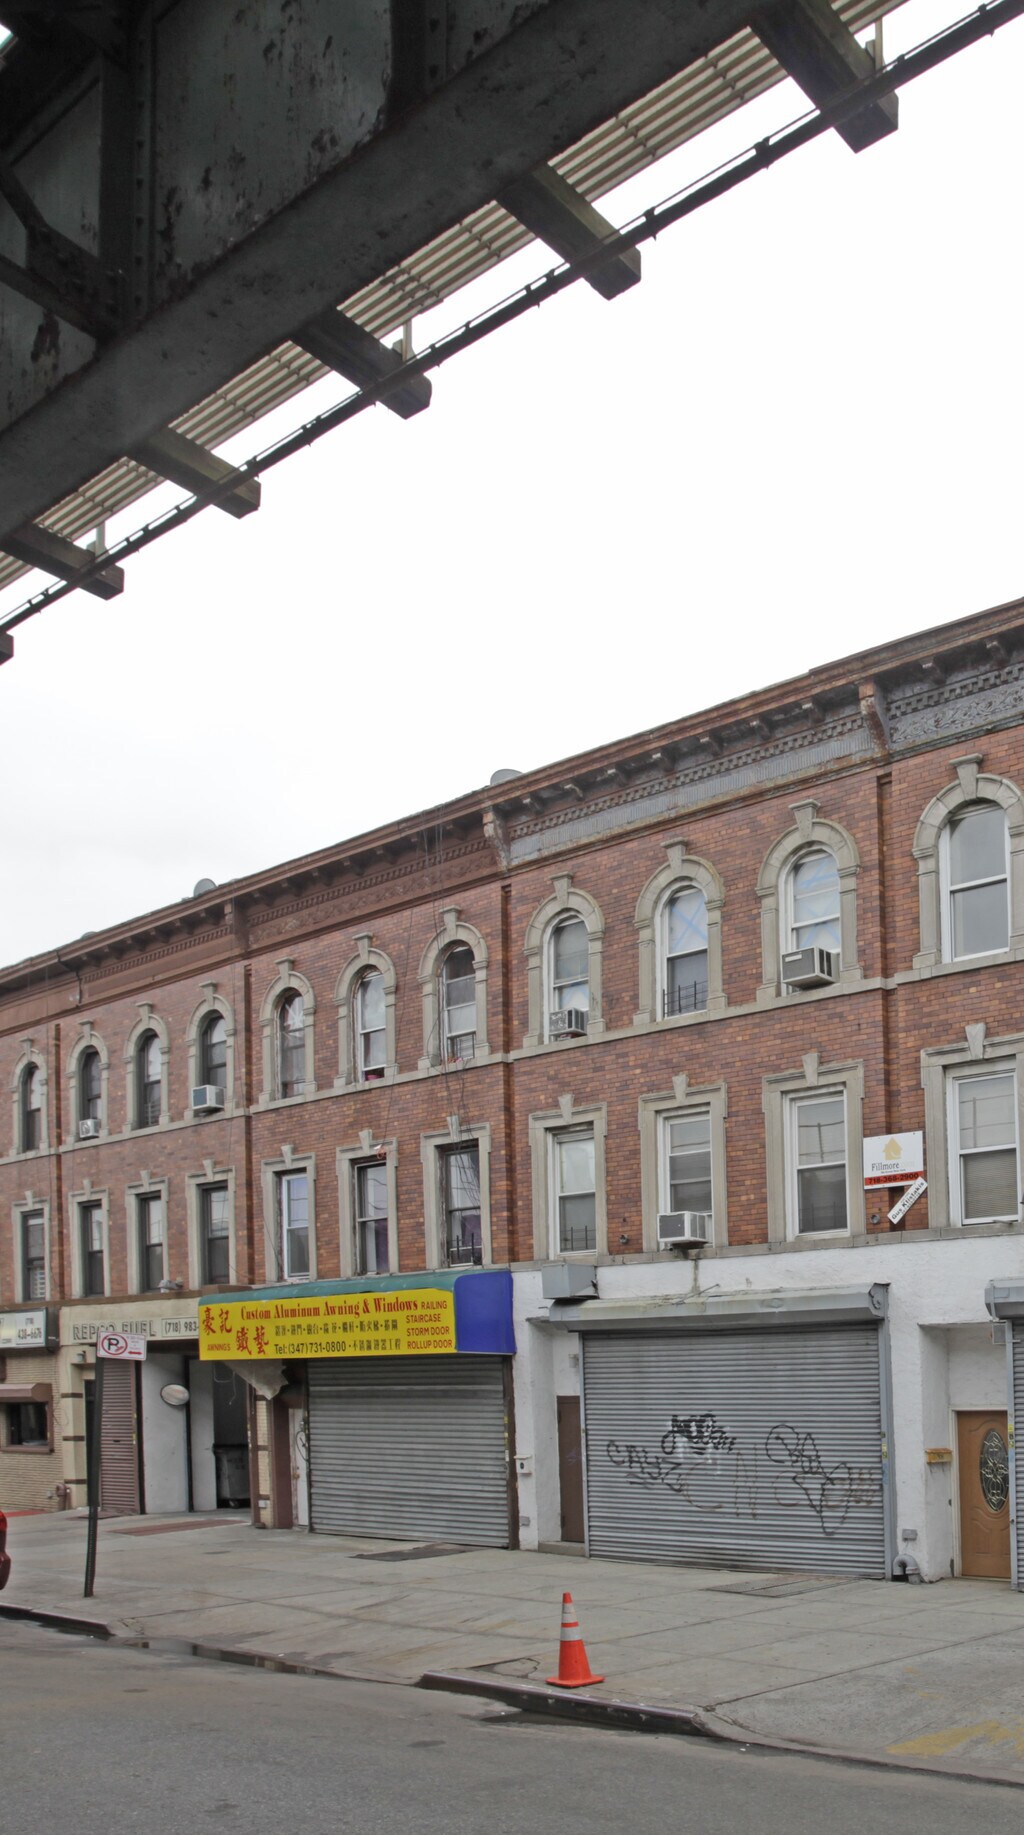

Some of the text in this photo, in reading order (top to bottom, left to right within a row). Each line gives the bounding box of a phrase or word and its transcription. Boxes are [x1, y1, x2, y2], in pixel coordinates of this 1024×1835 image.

[871, 1162, 900, 1172] Fillmore
[241, 1297, 418, 1320] Custom Aluminum Awning & Windows
[421, 1300, 447, 1310] RAILING
[406, 1313, 441, 1323] STAIRCASE
[165, 1321, 181, 1334] (718)
[407, 1327, 429, 1336] STORM
[431, 1326, 450, 1335] DOOR
[407, 1339, 452, 1350] ROLLUP DOOR
